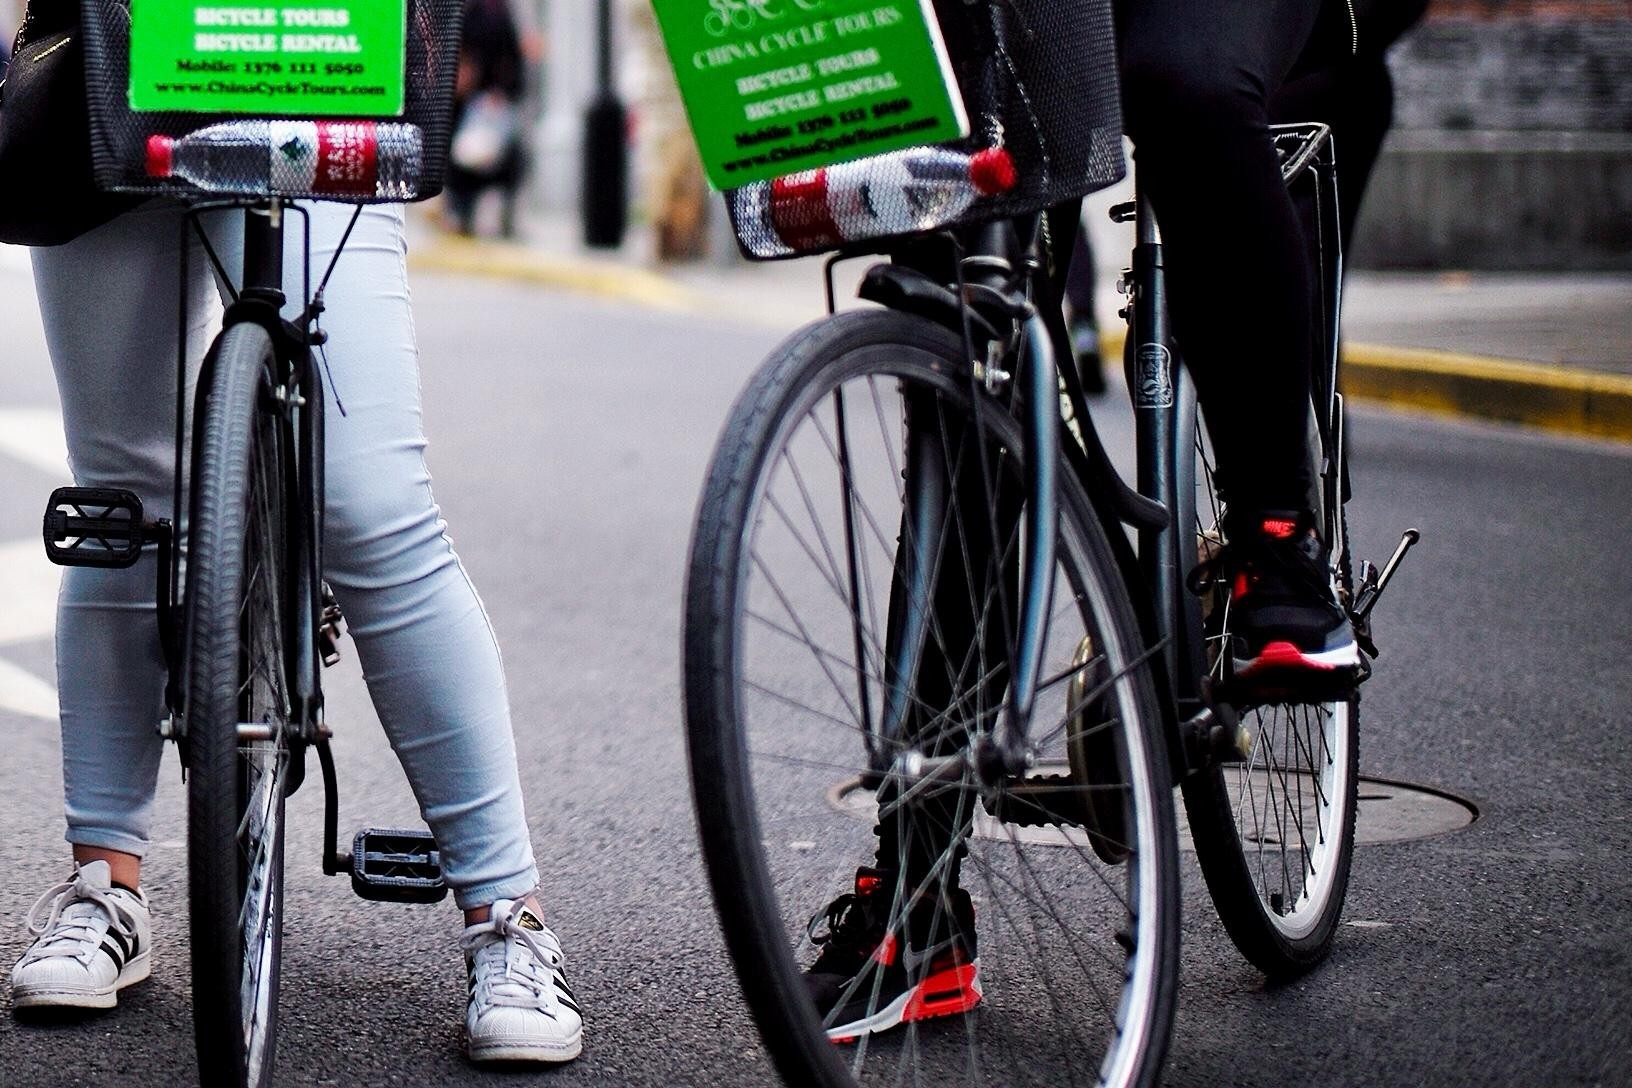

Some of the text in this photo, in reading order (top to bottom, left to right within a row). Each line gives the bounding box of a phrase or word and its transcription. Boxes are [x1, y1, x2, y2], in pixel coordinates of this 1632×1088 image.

[194, 7, 350, 27] BICYCLE TOURS
[194, 33, 362, 52] BICYCLE RENTAL
[692, 5, 903, 69] CHINA CYCLE TOURS
[176, 59, 364, 75] Mobile: 1376 111 5050
[735, 47, 881, 96] BICYCLE TOURS
[156, 81, 385, 96] www.ChinaCycleTours.com
[743, 71, 900, 122] BICYCLE RENTAL
